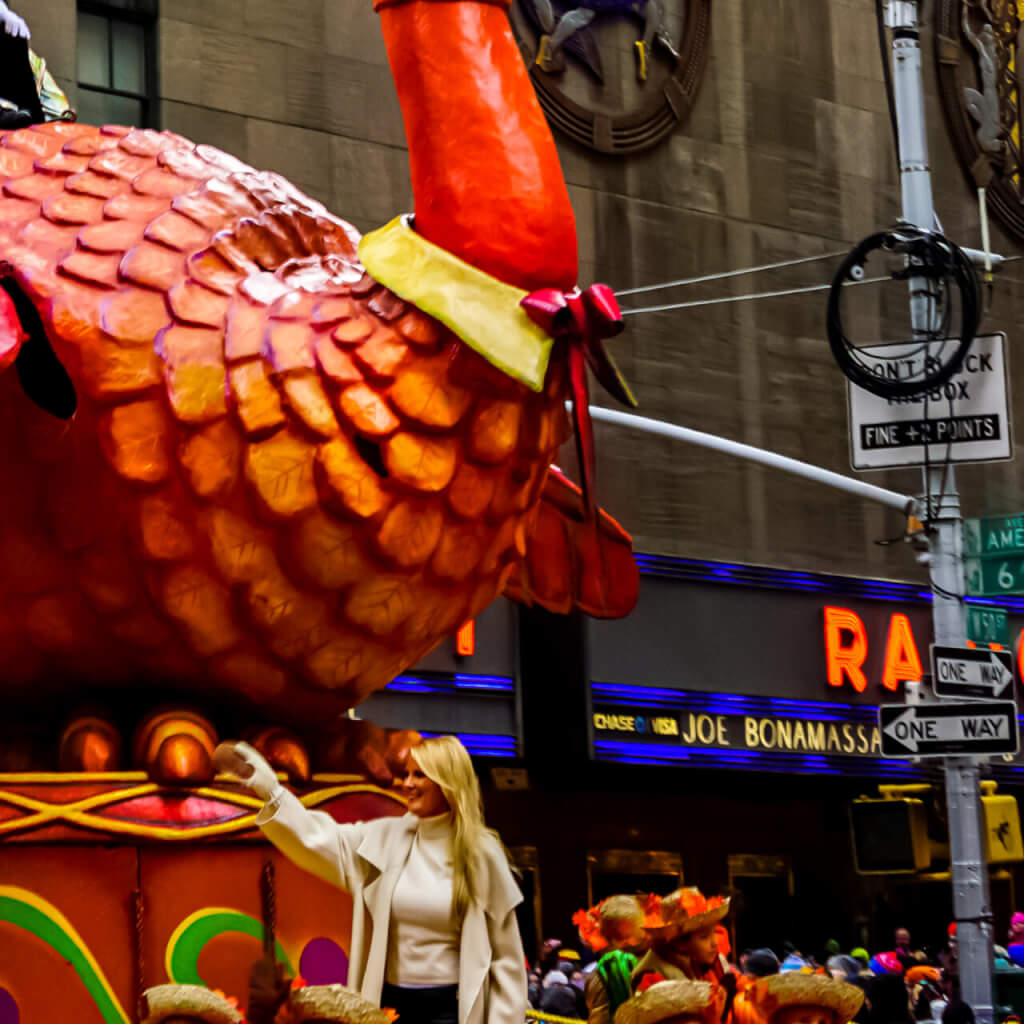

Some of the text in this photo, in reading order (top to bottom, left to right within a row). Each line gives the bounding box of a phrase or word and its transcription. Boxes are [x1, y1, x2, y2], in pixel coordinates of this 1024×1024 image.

[925, 353, 993, 378] BCK
[865, 426, 900, 446] FINE
[937, 418, 994, 440] POINTS
[998, 562, 1014, 589] 6
[940, 661, 1005, 684] ONE WAY
[593, 713, 679, 736] CHASE VISA
[682, 712, 880, 754] JOE BONAMASSA
[894, 717, 1003, 740] ONE WAY
